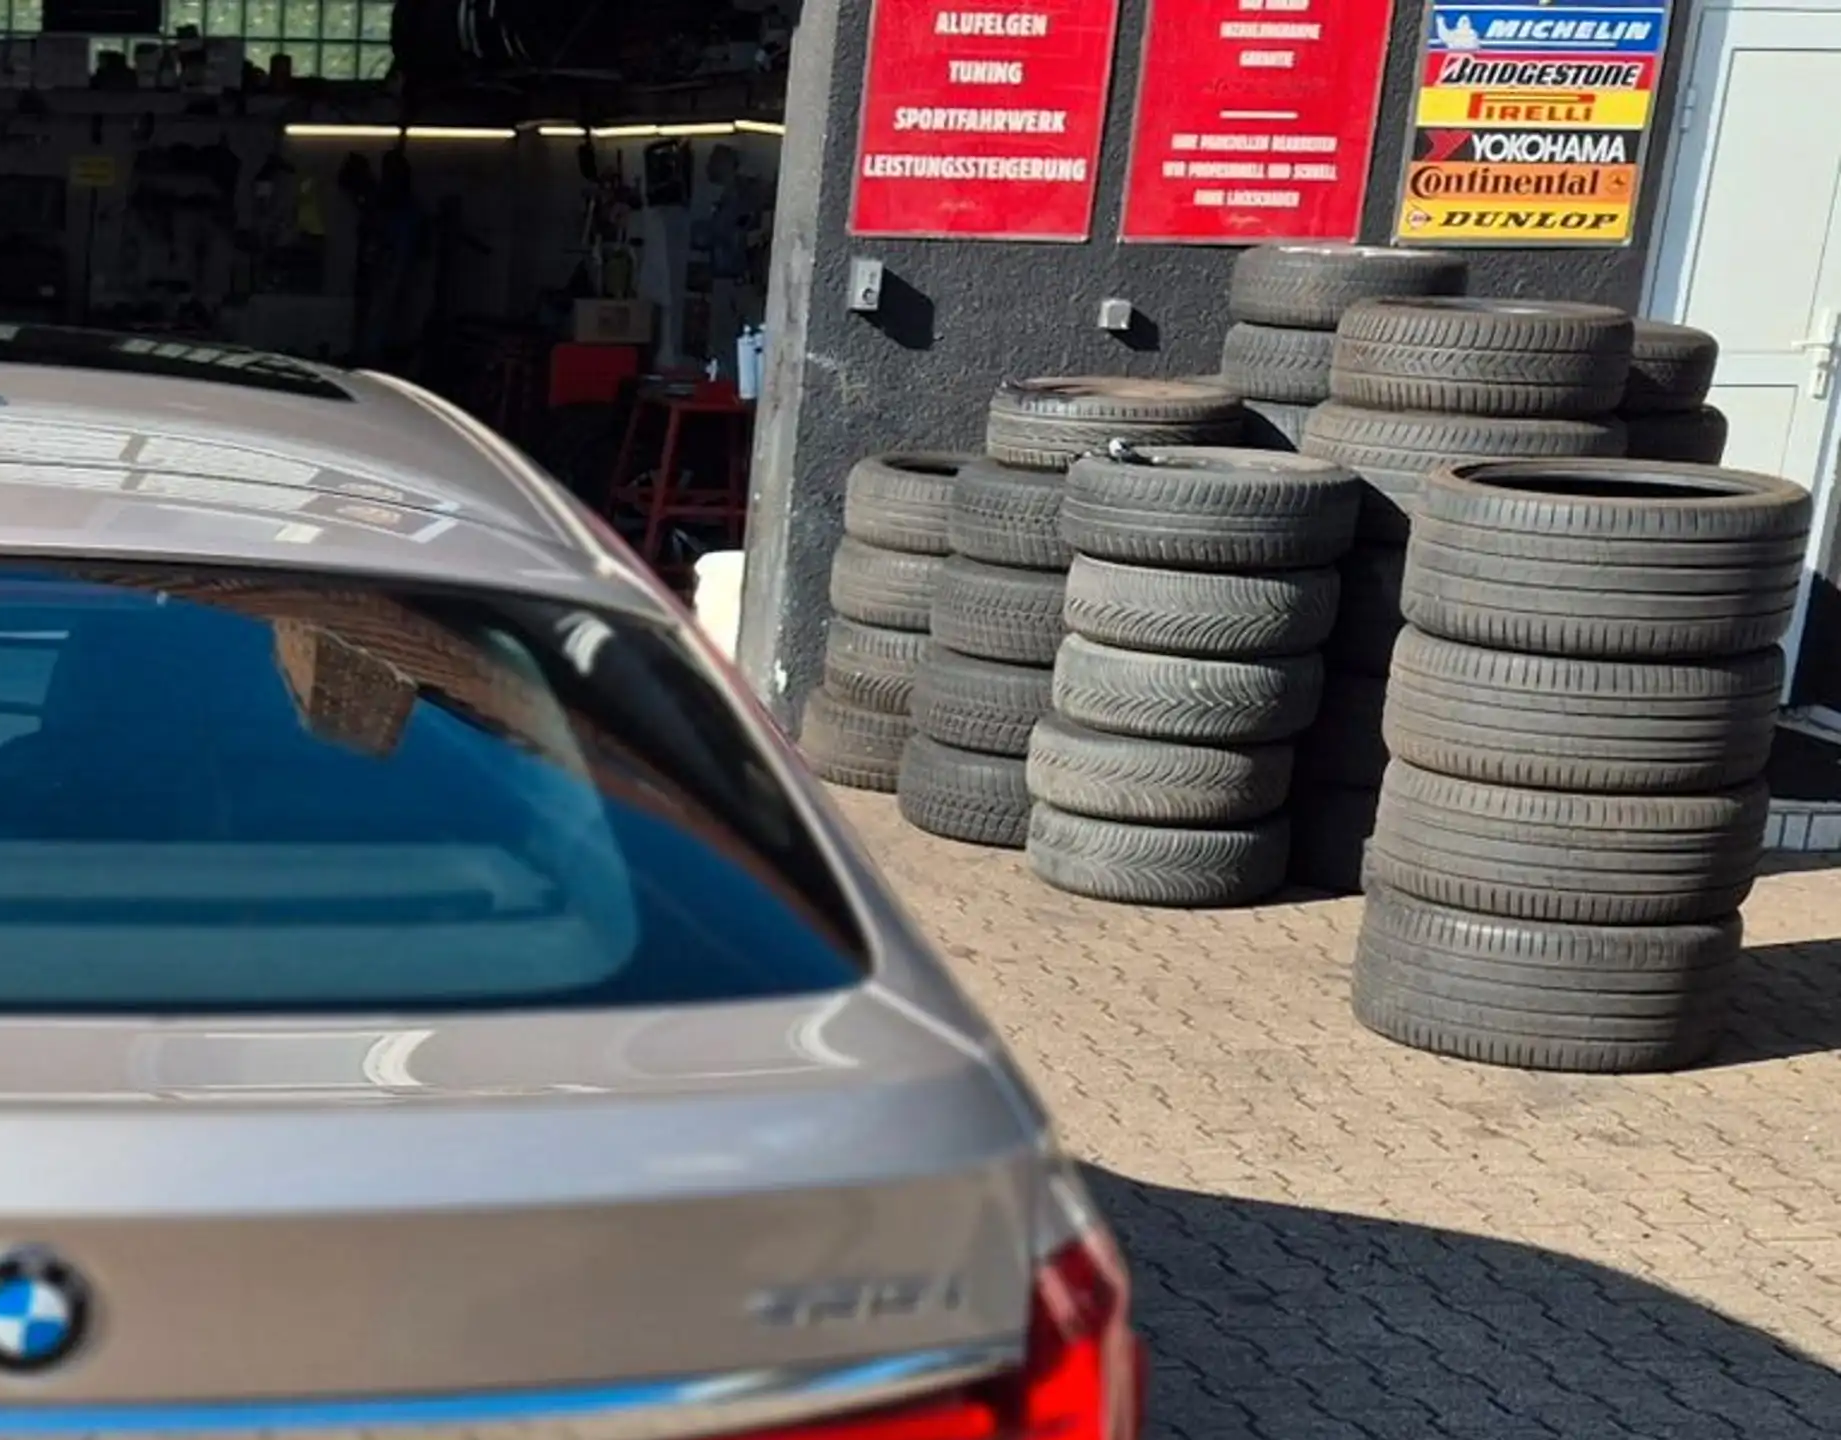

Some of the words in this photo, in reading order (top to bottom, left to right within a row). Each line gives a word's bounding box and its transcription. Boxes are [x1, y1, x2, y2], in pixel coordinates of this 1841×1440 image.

[934, 11, 1048, 37] ALUFELGEN
[1485, 20, 1651, 41] MICHELIN
[948, 60, 1023, 84] TUNING
[1440, 56, 1641, 88] BRIDGESTONE
[893, 107, 1067, 133] SPORTFAHRWERK
[1471, 133, 1627, 162] YOKOHAMA
[862, 153, 1087, 181] LEISTUNGSSTEIGERUNG
[1411, 166, 1599, 199] Continental
[1439, 211, 1618, 229] DUNLOP
